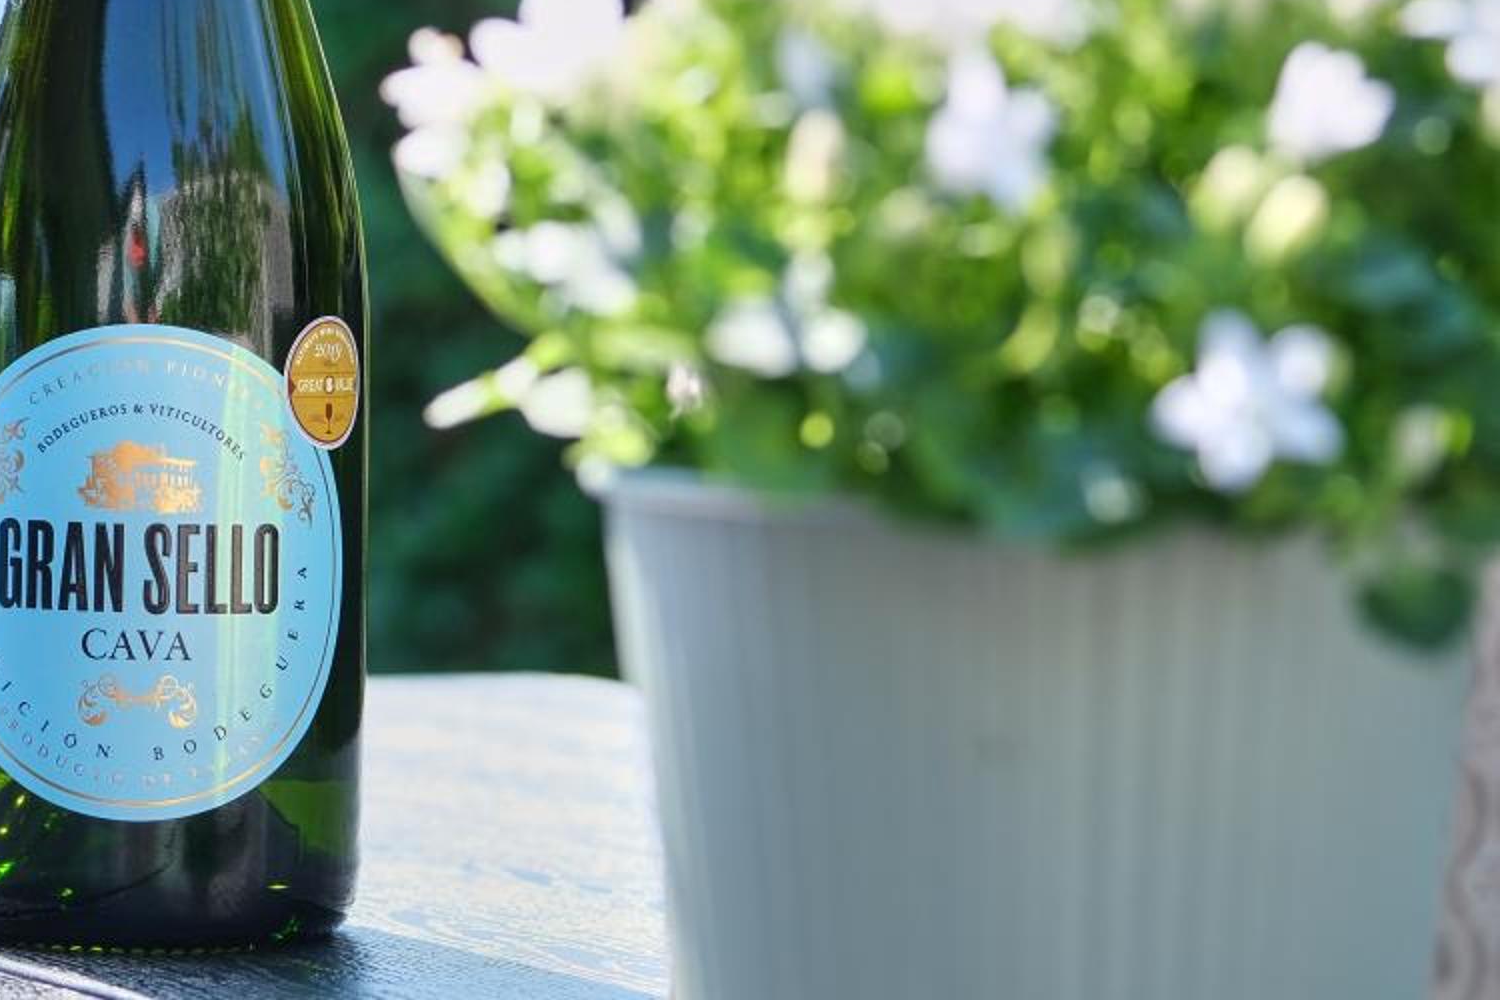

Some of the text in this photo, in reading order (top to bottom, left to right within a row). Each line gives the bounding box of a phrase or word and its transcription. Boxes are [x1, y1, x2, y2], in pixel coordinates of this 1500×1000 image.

[37, 402, 247, 461] BODEGUEROS & VITICULTORES
[143, 523, 280, 615] SELLO
[81, 627, 192, 662] CAVA
[153, 565, 308, 762] BODEGUERA
